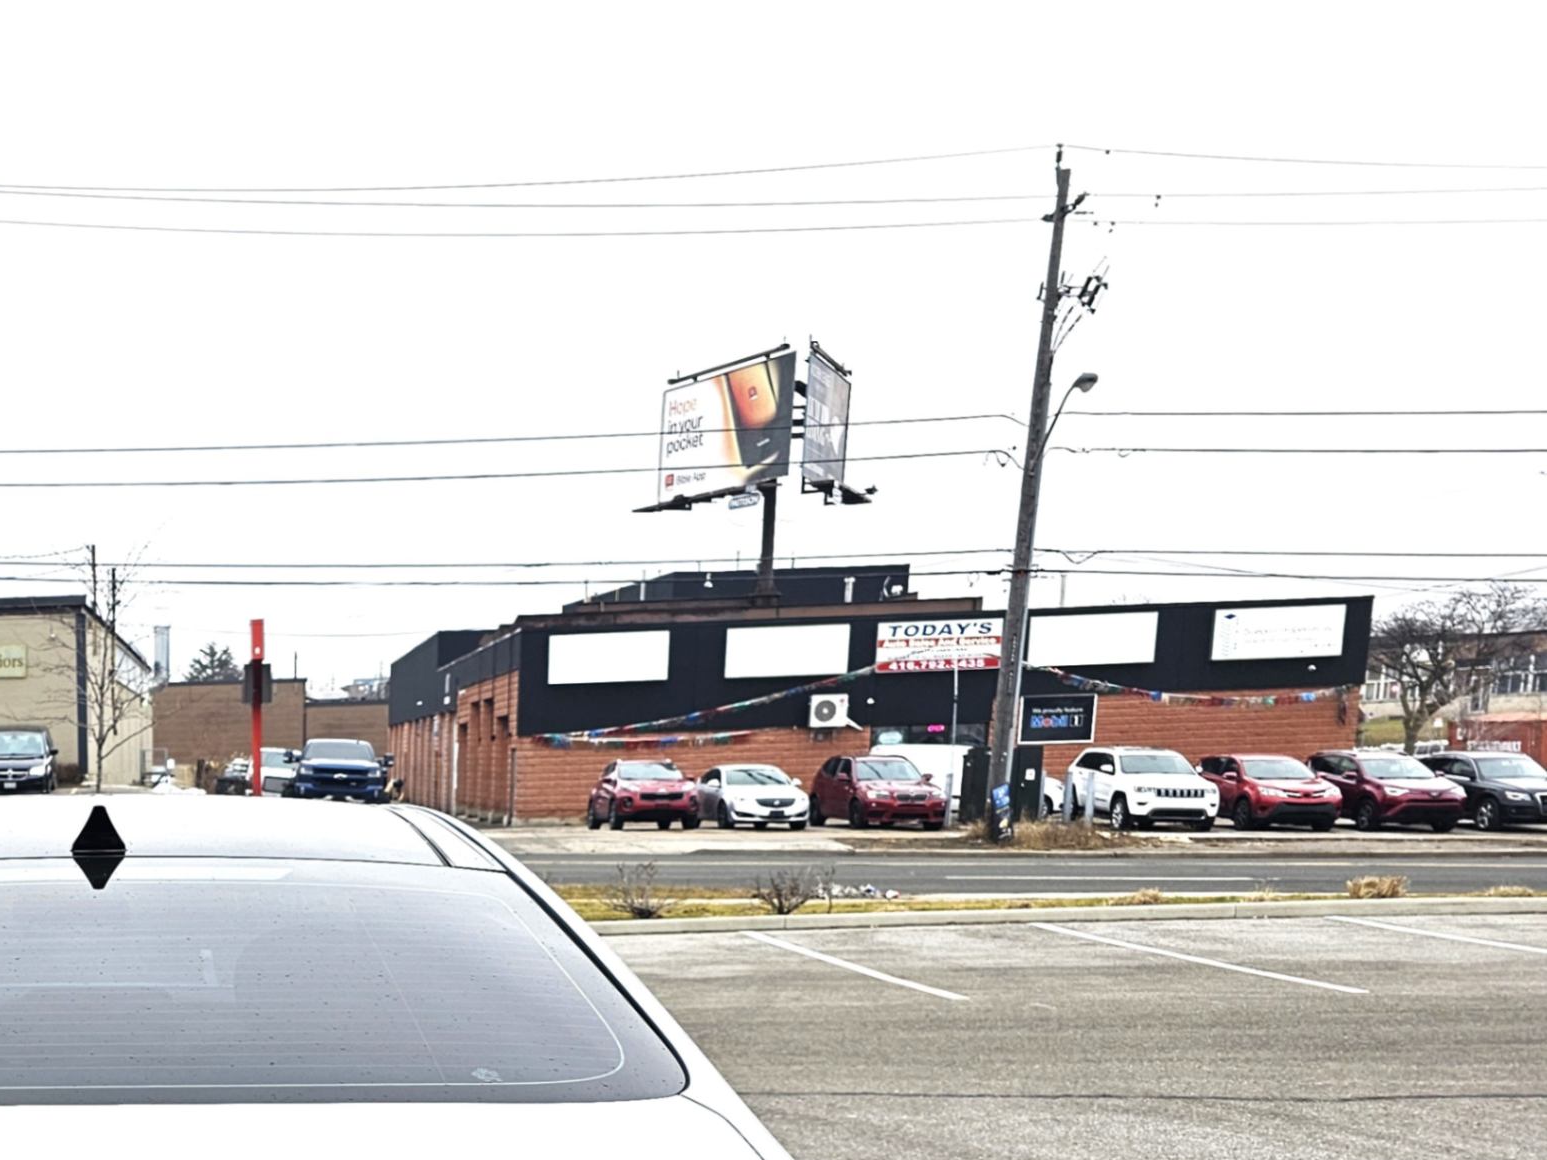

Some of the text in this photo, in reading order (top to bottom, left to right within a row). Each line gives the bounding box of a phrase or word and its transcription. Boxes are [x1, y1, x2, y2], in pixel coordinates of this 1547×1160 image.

[668, 398, 698, 416] Hope
[667, 415, 704, 438] in your
[665, 431, 704, 458] pocket
[888, 622, 993, 637] TODAY'S
[1030, 714, 1069, 729] Mobil
